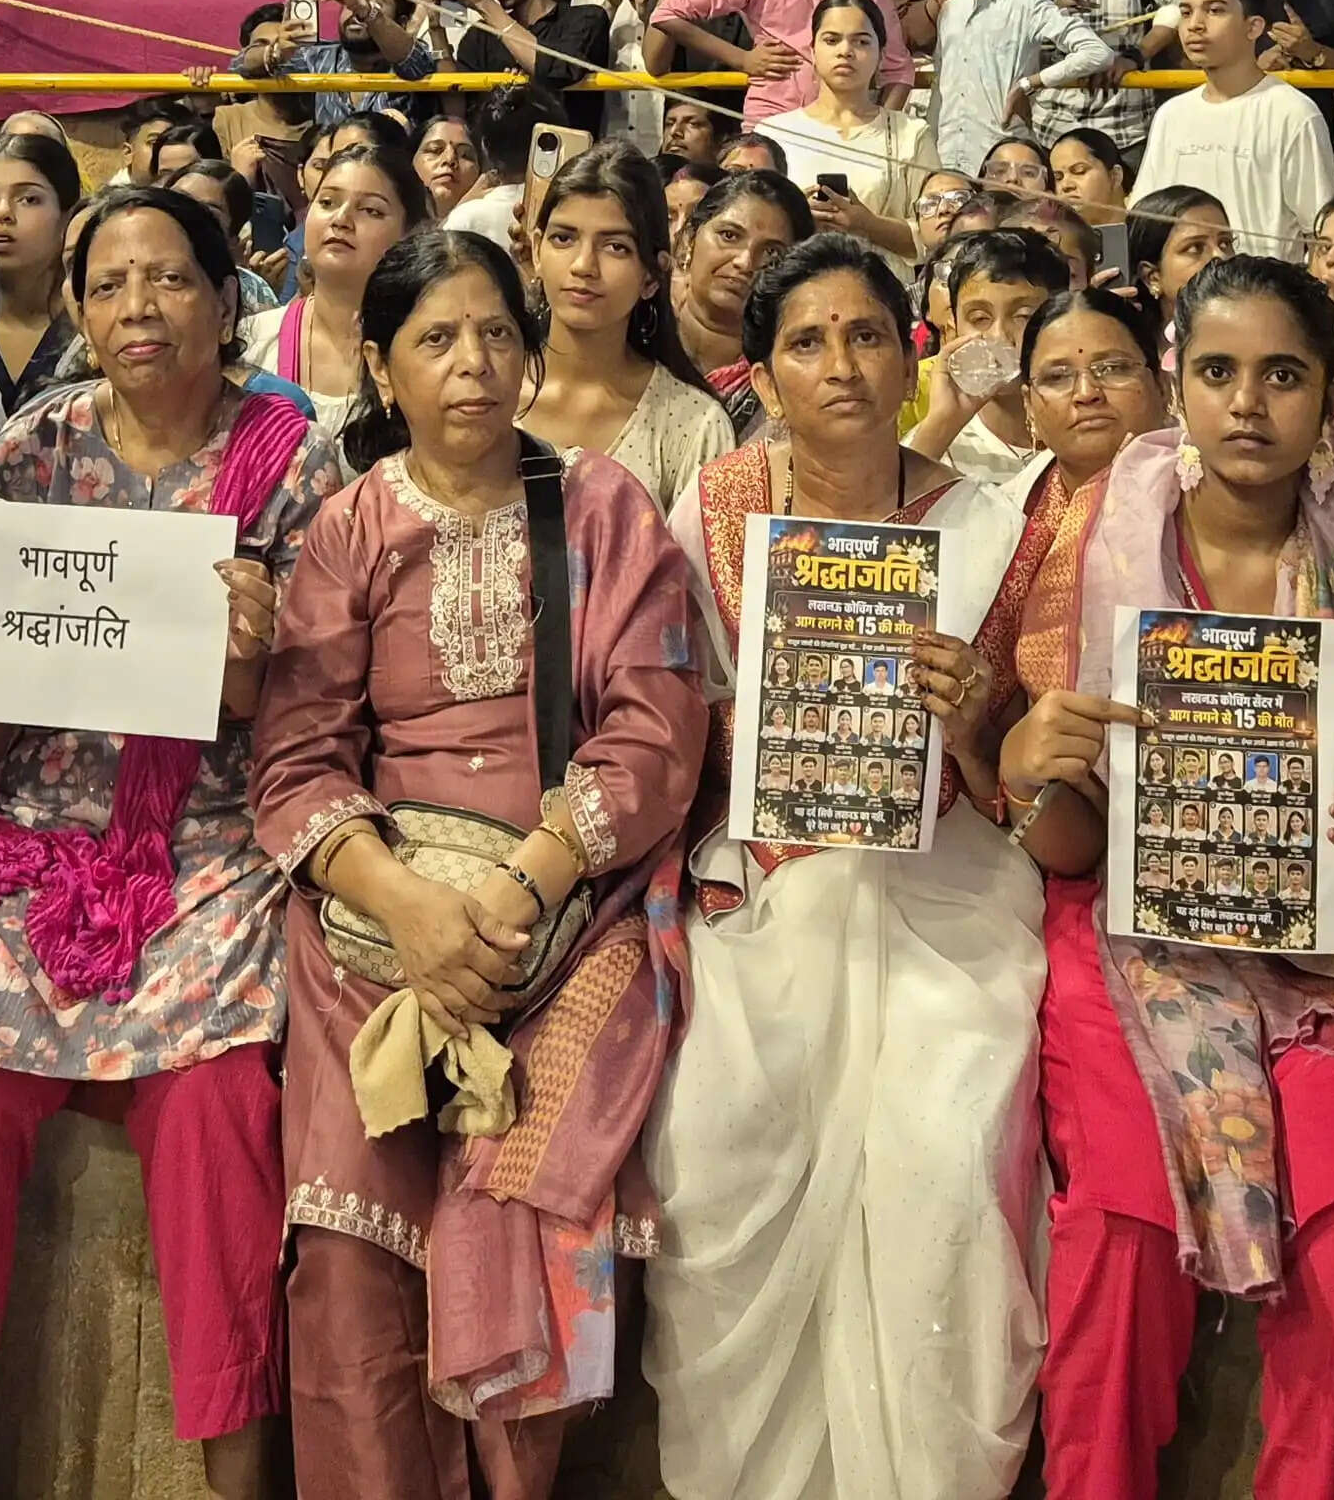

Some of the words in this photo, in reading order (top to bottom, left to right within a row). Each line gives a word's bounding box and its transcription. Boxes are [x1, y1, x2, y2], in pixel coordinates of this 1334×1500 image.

[827, 536, 879, 559] भावपूर्ण
[19, 540, 119, 592] भावपूर्ण
[795, 552, 920, 593] श्रद्धांजलि
[808, 600, 842, 612] लखनऊ
[844, 600, 873, 614] कोचिंग
[875, 602, 894, 616] सेंटर
[896, 603, 905, 617] में
[2, 605, 130, 650] श्रद्धांजलि
[795, 616, 816, 628] आग
[817, 616, 842, 630] लगने
[844, 618, 855, 632] से
[856, 616, 877, 635] 15
[878, 619, 892, 634] की
[894, 620, 914, 635] मौत
[1202, 627, 1257, 651] भावपूर्ण
[1167, 644, 1300, 683] श्रद्धांजलि
[1181, 692, 1218, 704] लखनऊ
[1220, 692, 1251, 708] कोचिंग
[1252, 694, 1273, 709] सेंटर
[1275, 695, 1283, 709] में
[1169, 709, 1190, 723] आग
[1193, 708, 1219, 724] लगने
[1221, 710, 1232, 725] से
[1234, 709, 1256, 729] 15
[1258, 712, 1272, 727] की
[1274, 713, 1294, 728] मौत
